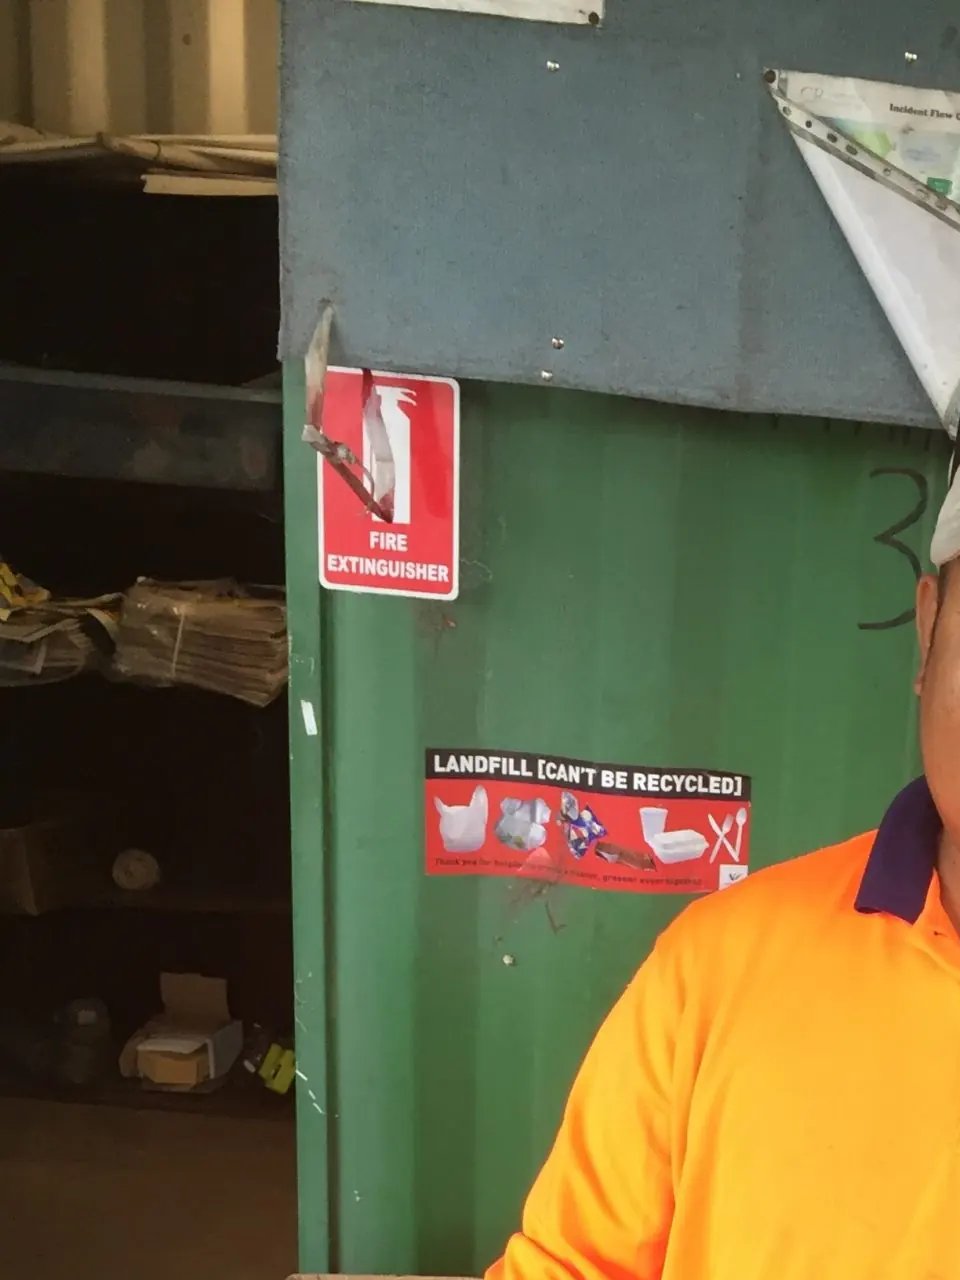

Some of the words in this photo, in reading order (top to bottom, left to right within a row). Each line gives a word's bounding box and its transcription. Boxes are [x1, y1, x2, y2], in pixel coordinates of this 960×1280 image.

[890, 103, 927, 116] Incident
[370, 531, 408, 552] FIRE
[328, 554, 449, 582] EXTINGUISHER
[434, 755, 533, 777] LANDFILL
[538, 760, 596, 786] [CAN'T
[601, 770, 627, 789] BE
[633, 773, 742, 796] RECYCLED]
